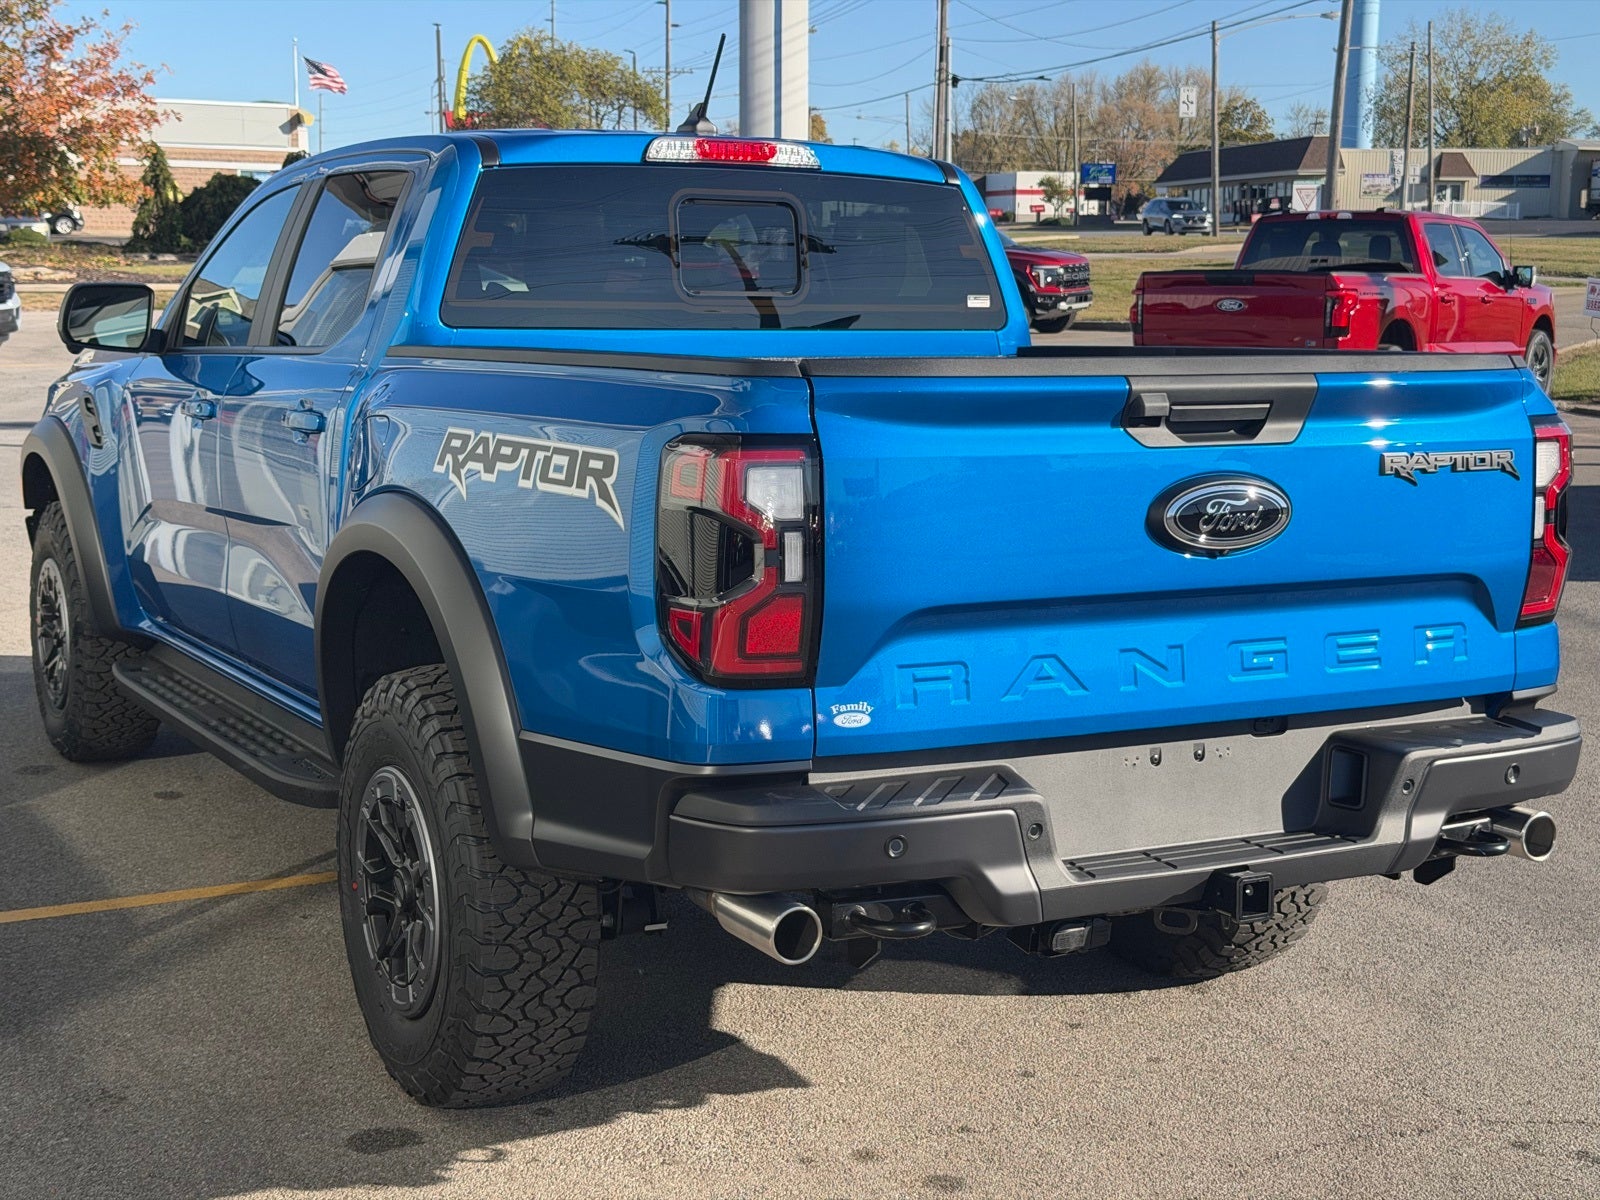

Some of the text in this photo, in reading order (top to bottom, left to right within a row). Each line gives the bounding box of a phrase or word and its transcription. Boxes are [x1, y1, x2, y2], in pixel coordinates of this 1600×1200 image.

[433, 426, 625, 531] RAPTOR
[1380, 449, 1521, 486] RAPTOR
[1199, 498, 1264, 532] Ford
[895, 621, 1468, 709] RANGER
[830, 701, 874, 715] Family
[841, 714, 864, 725] Ford
